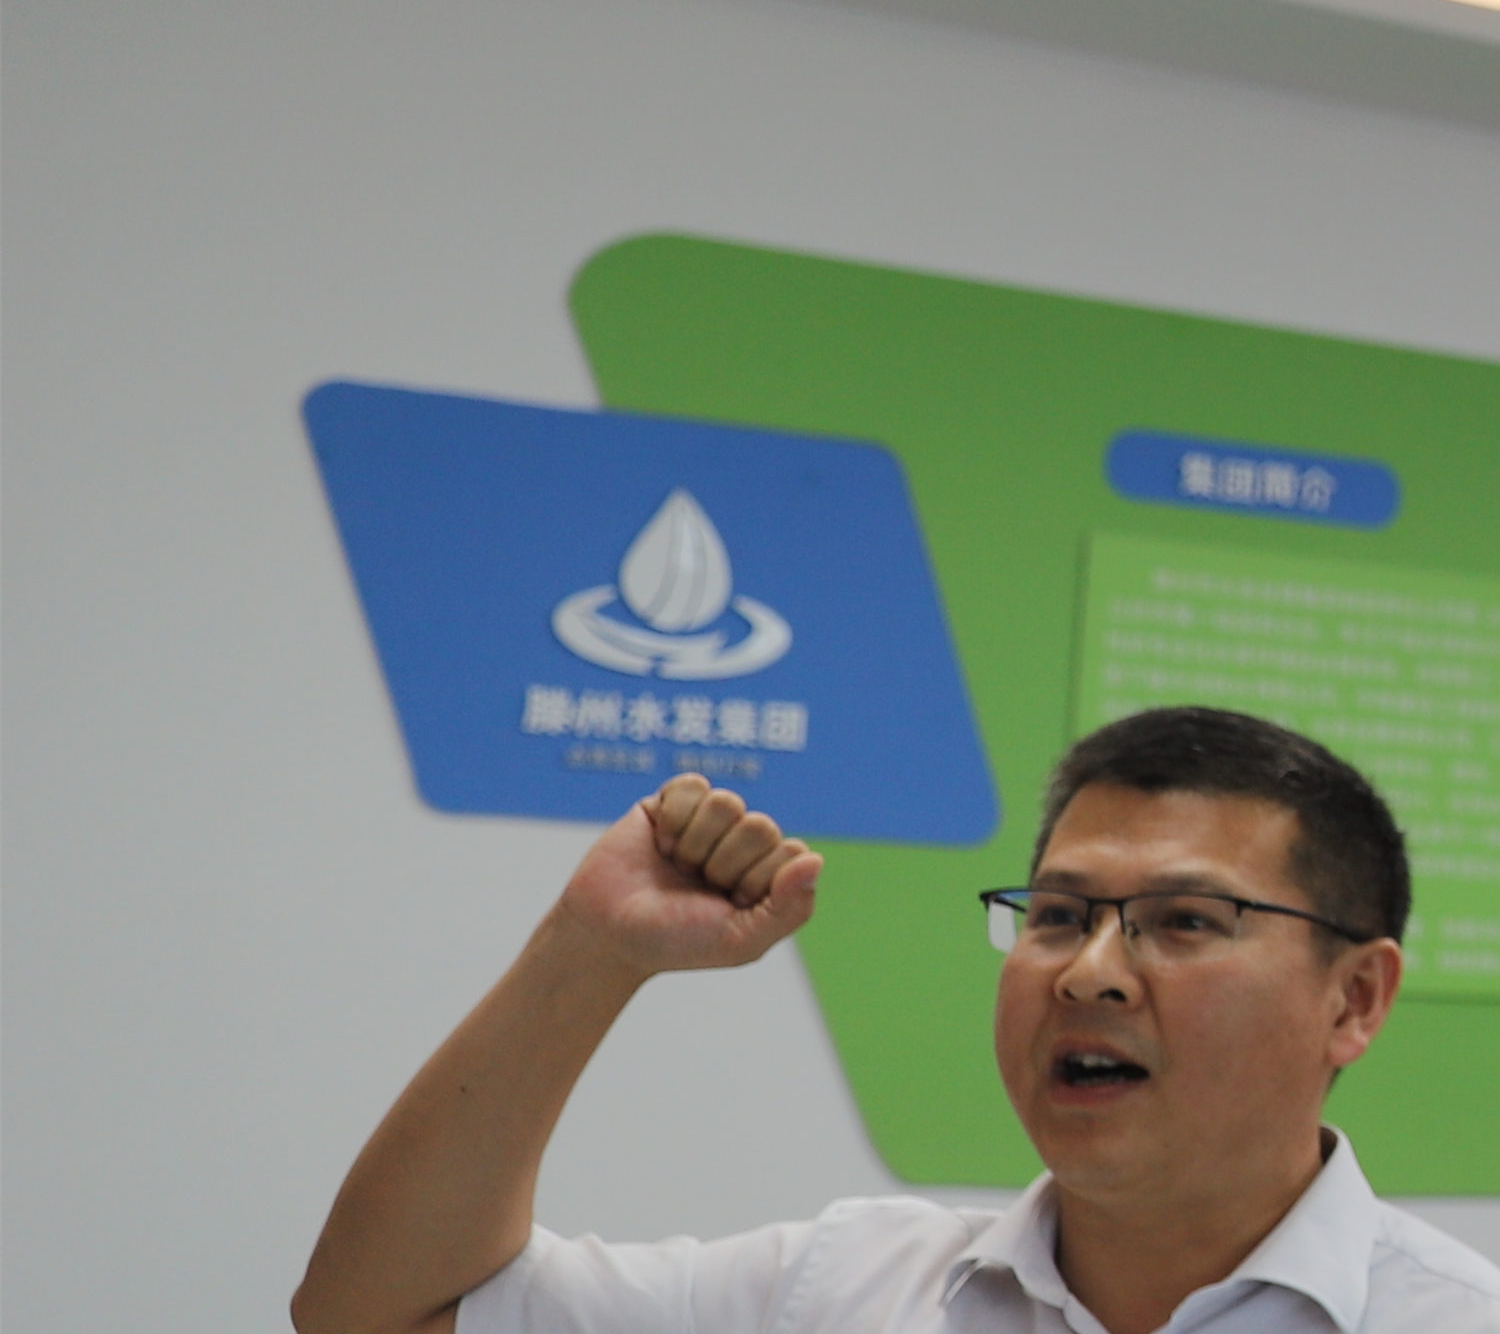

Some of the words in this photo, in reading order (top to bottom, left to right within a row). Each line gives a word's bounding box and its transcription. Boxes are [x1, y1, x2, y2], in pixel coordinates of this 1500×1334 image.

[1180, 453, 1336, 513] 集团简介
[521, 682, 808, 752] 滕州水发集团
